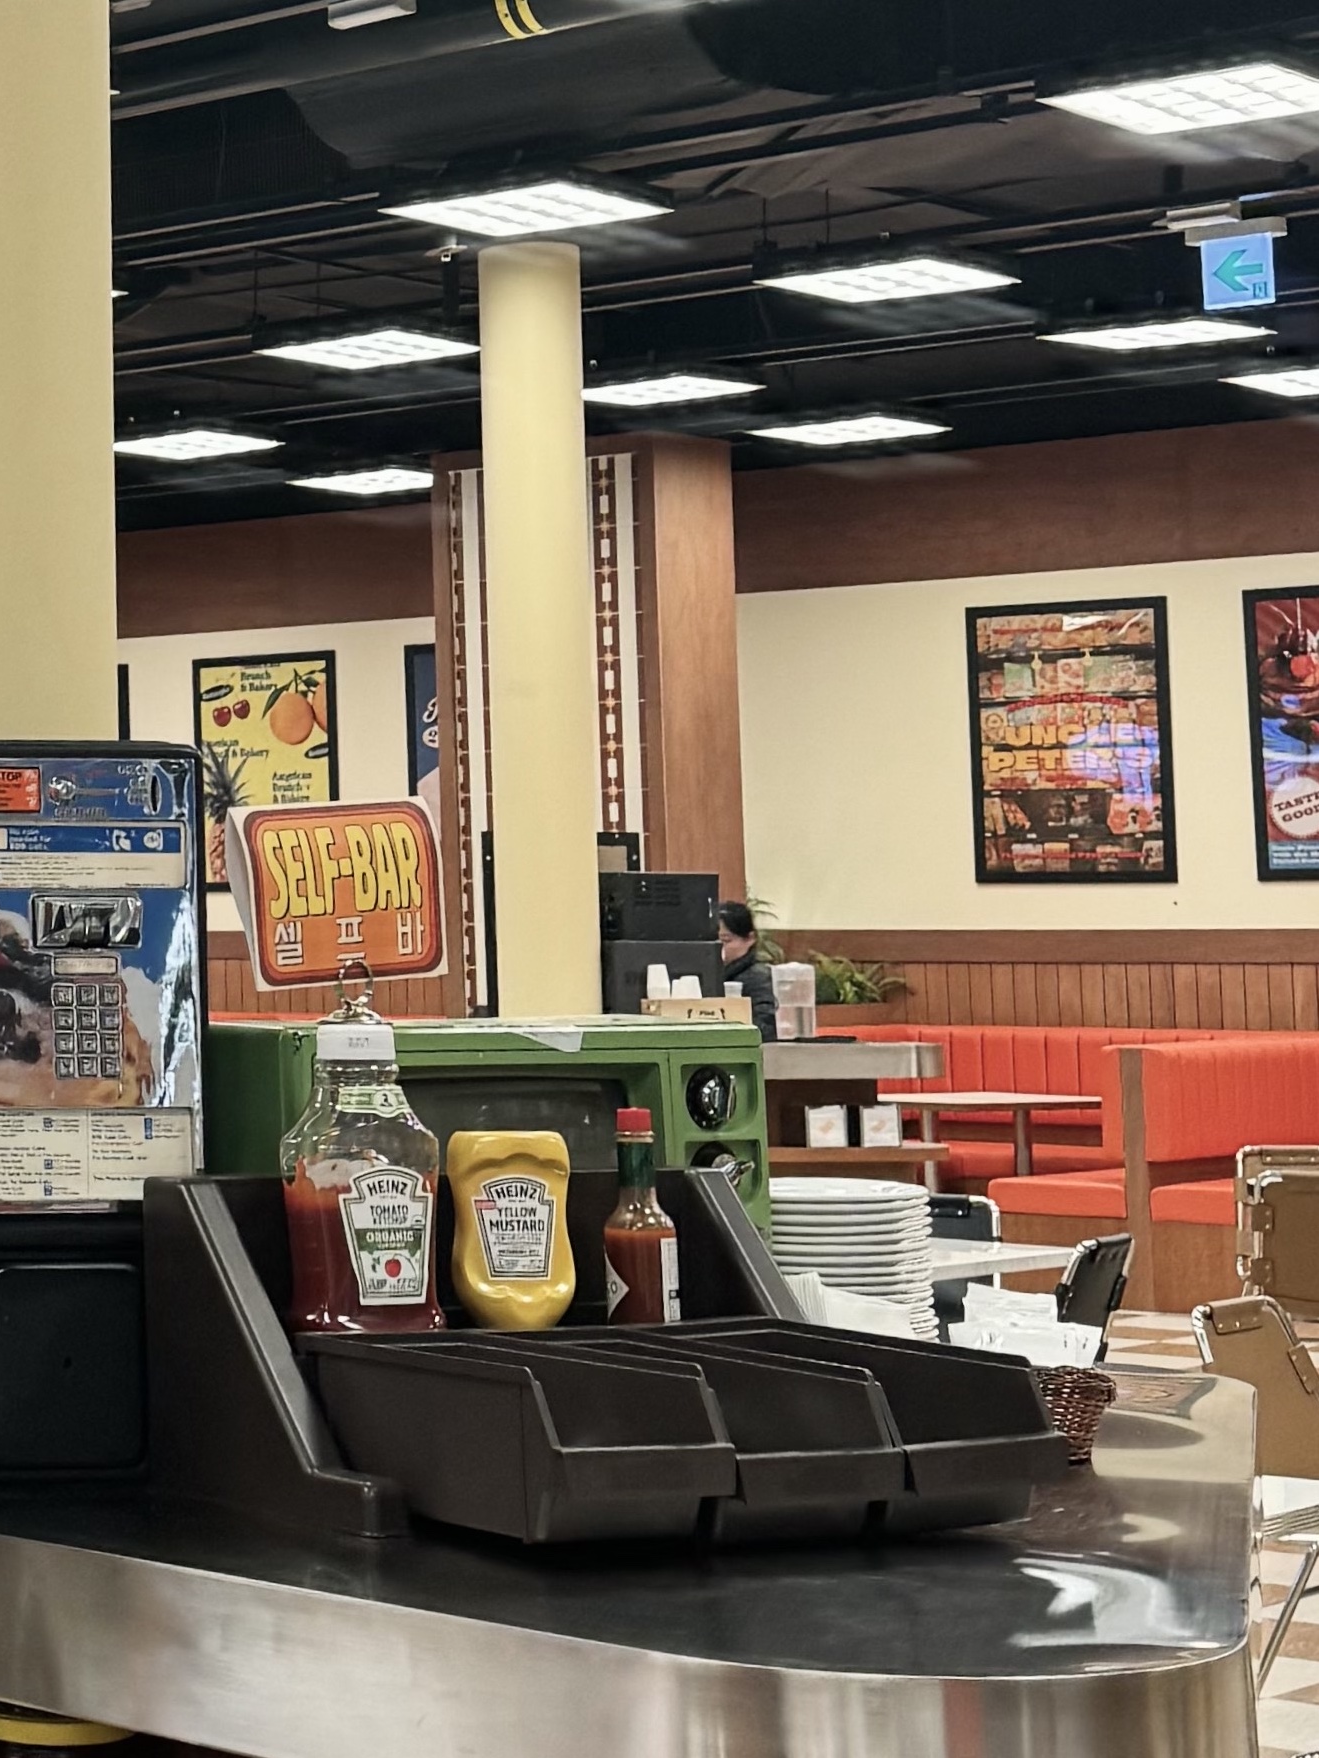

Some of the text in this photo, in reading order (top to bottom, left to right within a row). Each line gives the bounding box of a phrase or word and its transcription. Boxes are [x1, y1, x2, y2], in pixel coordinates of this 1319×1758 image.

[261, 820, 423, 920] SELF-BAR
[366, 1179, 409, 1198] HEINZ
[494, 1184, 538, 1201] HEINZ
[369, 1204, 409, 1218] TOMATO
[497, 1206, 538, 1219] YELLOW
[371, 1215, 409, 1227] KETCHUP
[489, 1219, 545, 1233] MUSTARD
[365, 1230, 415, 1243] ORGANIC
